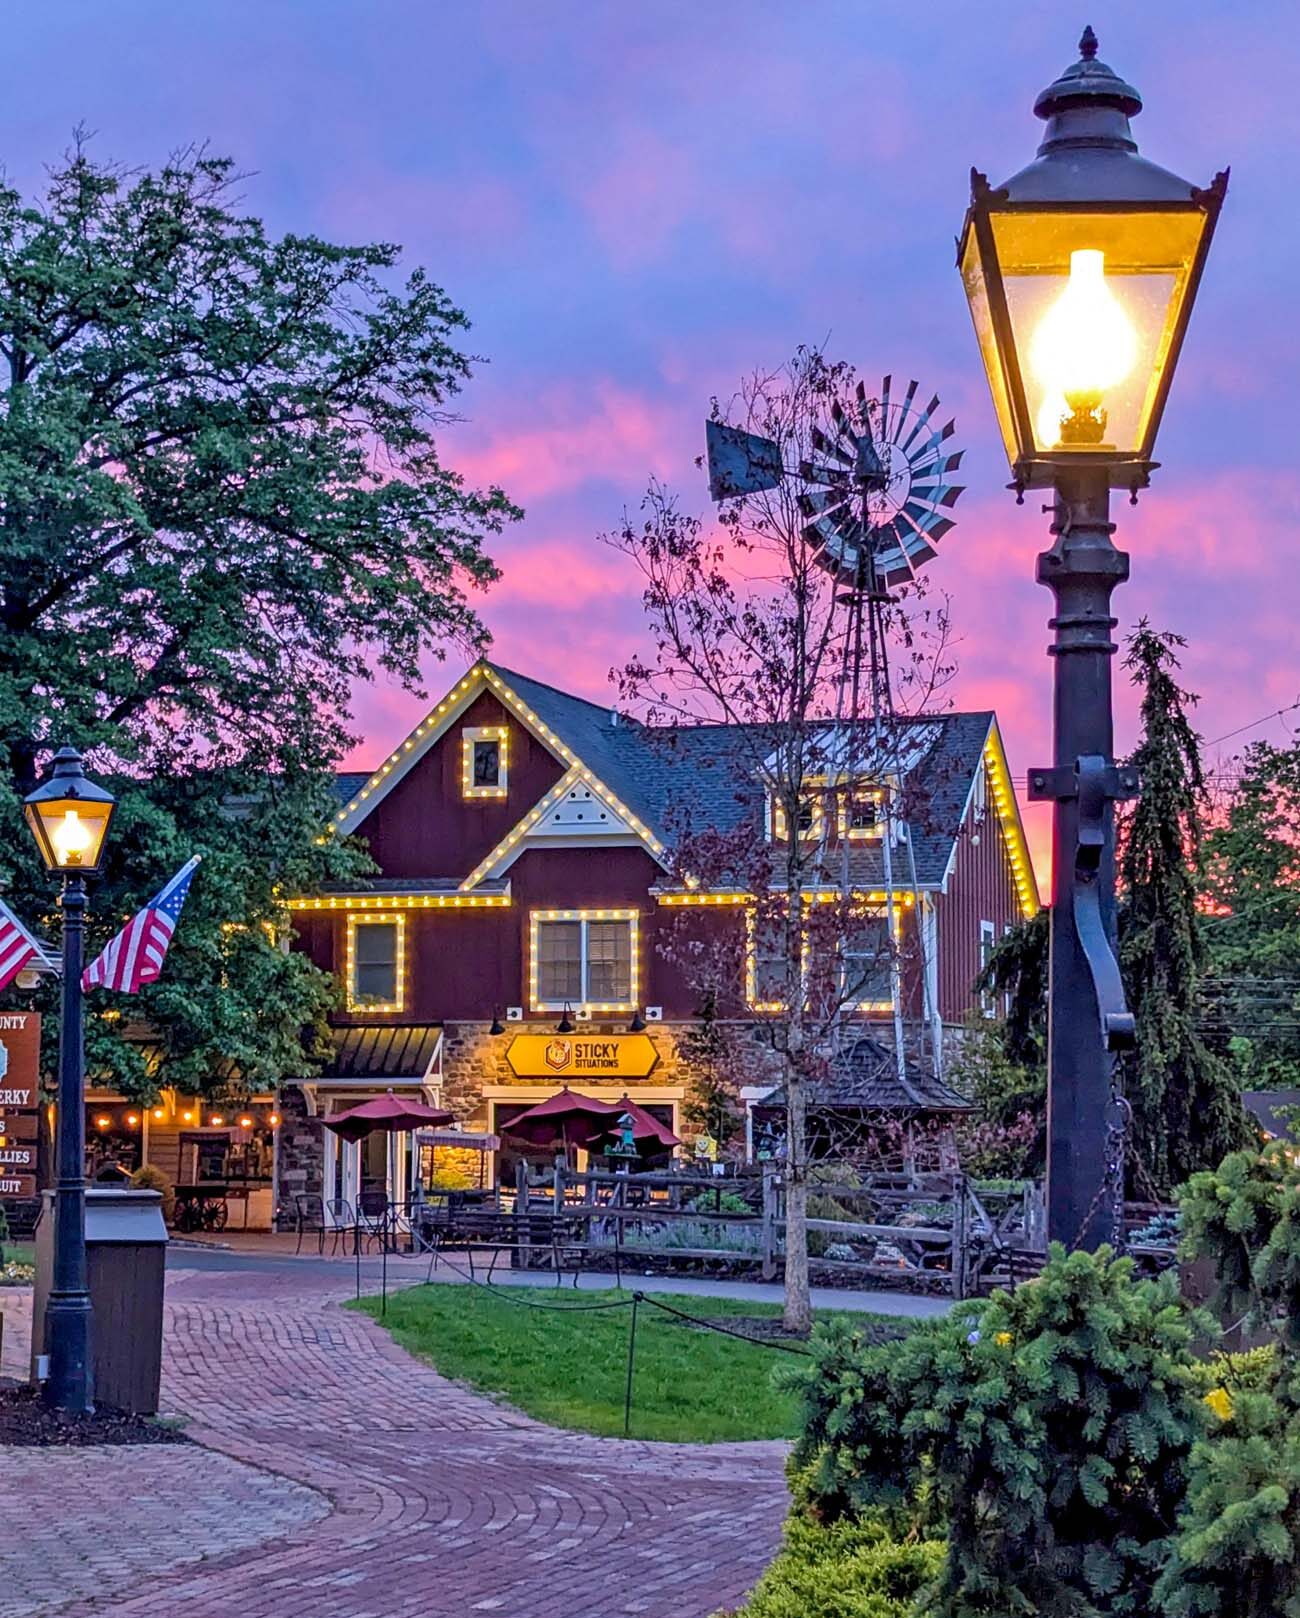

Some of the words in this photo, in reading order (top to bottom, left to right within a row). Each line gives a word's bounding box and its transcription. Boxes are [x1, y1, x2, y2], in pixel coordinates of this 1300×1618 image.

[575, 1043, 619, 1058] STICKY
[575, 1059, 619, 1068] SITUATIONS
[0, 1180, 21, 1192] UIT
